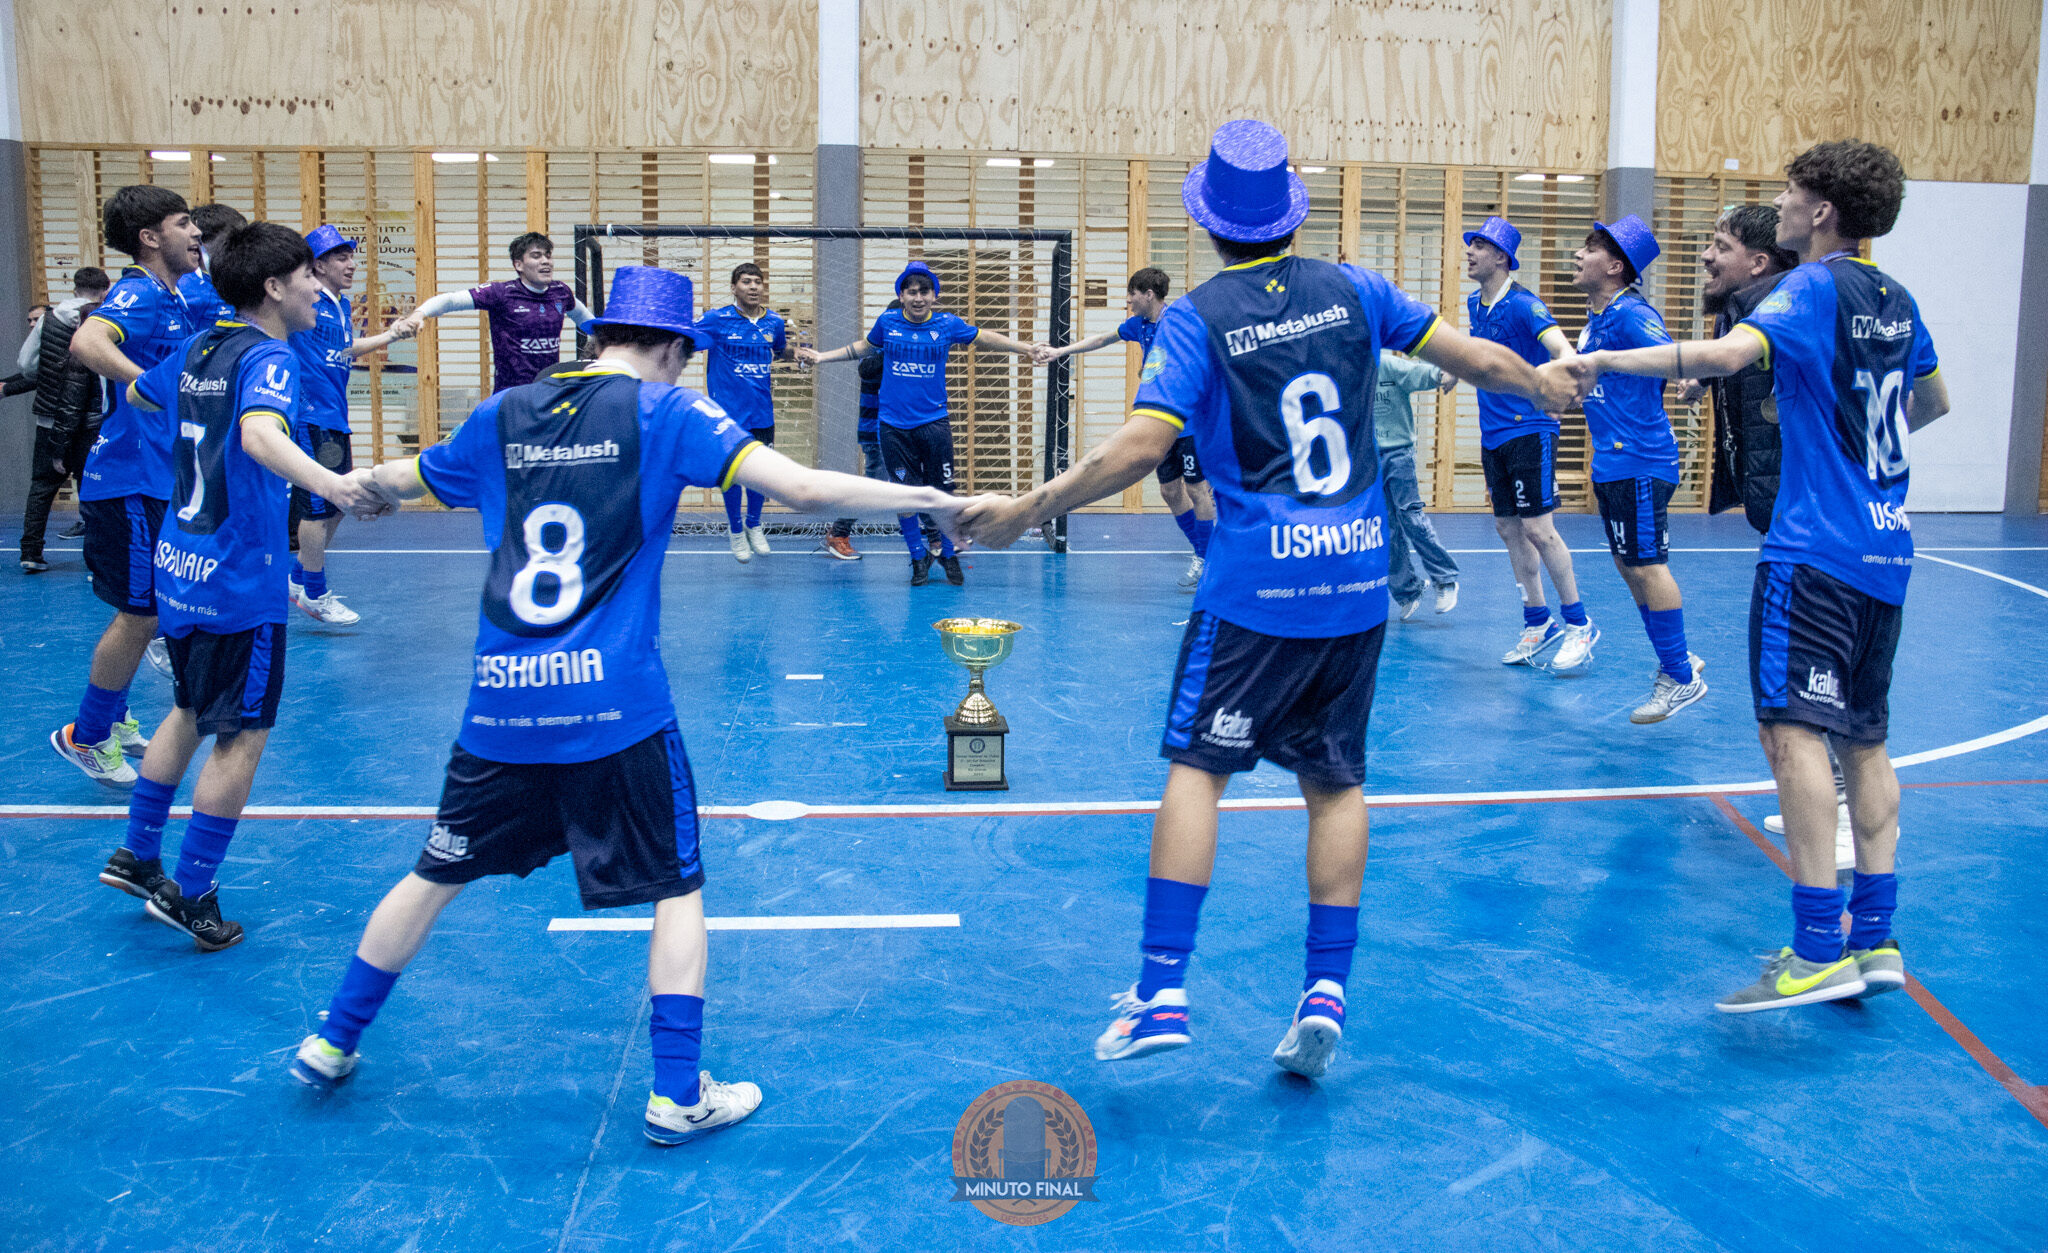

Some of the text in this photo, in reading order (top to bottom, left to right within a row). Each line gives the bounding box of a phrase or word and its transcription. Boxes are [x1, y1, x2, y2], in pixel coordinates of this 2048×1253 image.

[1255, 304, 1349, 341] Metalush
[891, 361, 936, 374] ZAPCO
[1280, 372, 1351, 496] 6
[1855, 370, 1910, 480] 10
[523, 440, 620, 462] Metalush
[1182, 454, 1195, 471] 13
[177, 421, 206, 521] 7
[943, 462, 952, 478] 5
[1515, 480, 1526, 499] 2
[1270, 515, 1384, 560] USHUAIA
[509, 503, 585, 626] 8
[198, 605, 219, 616] más
